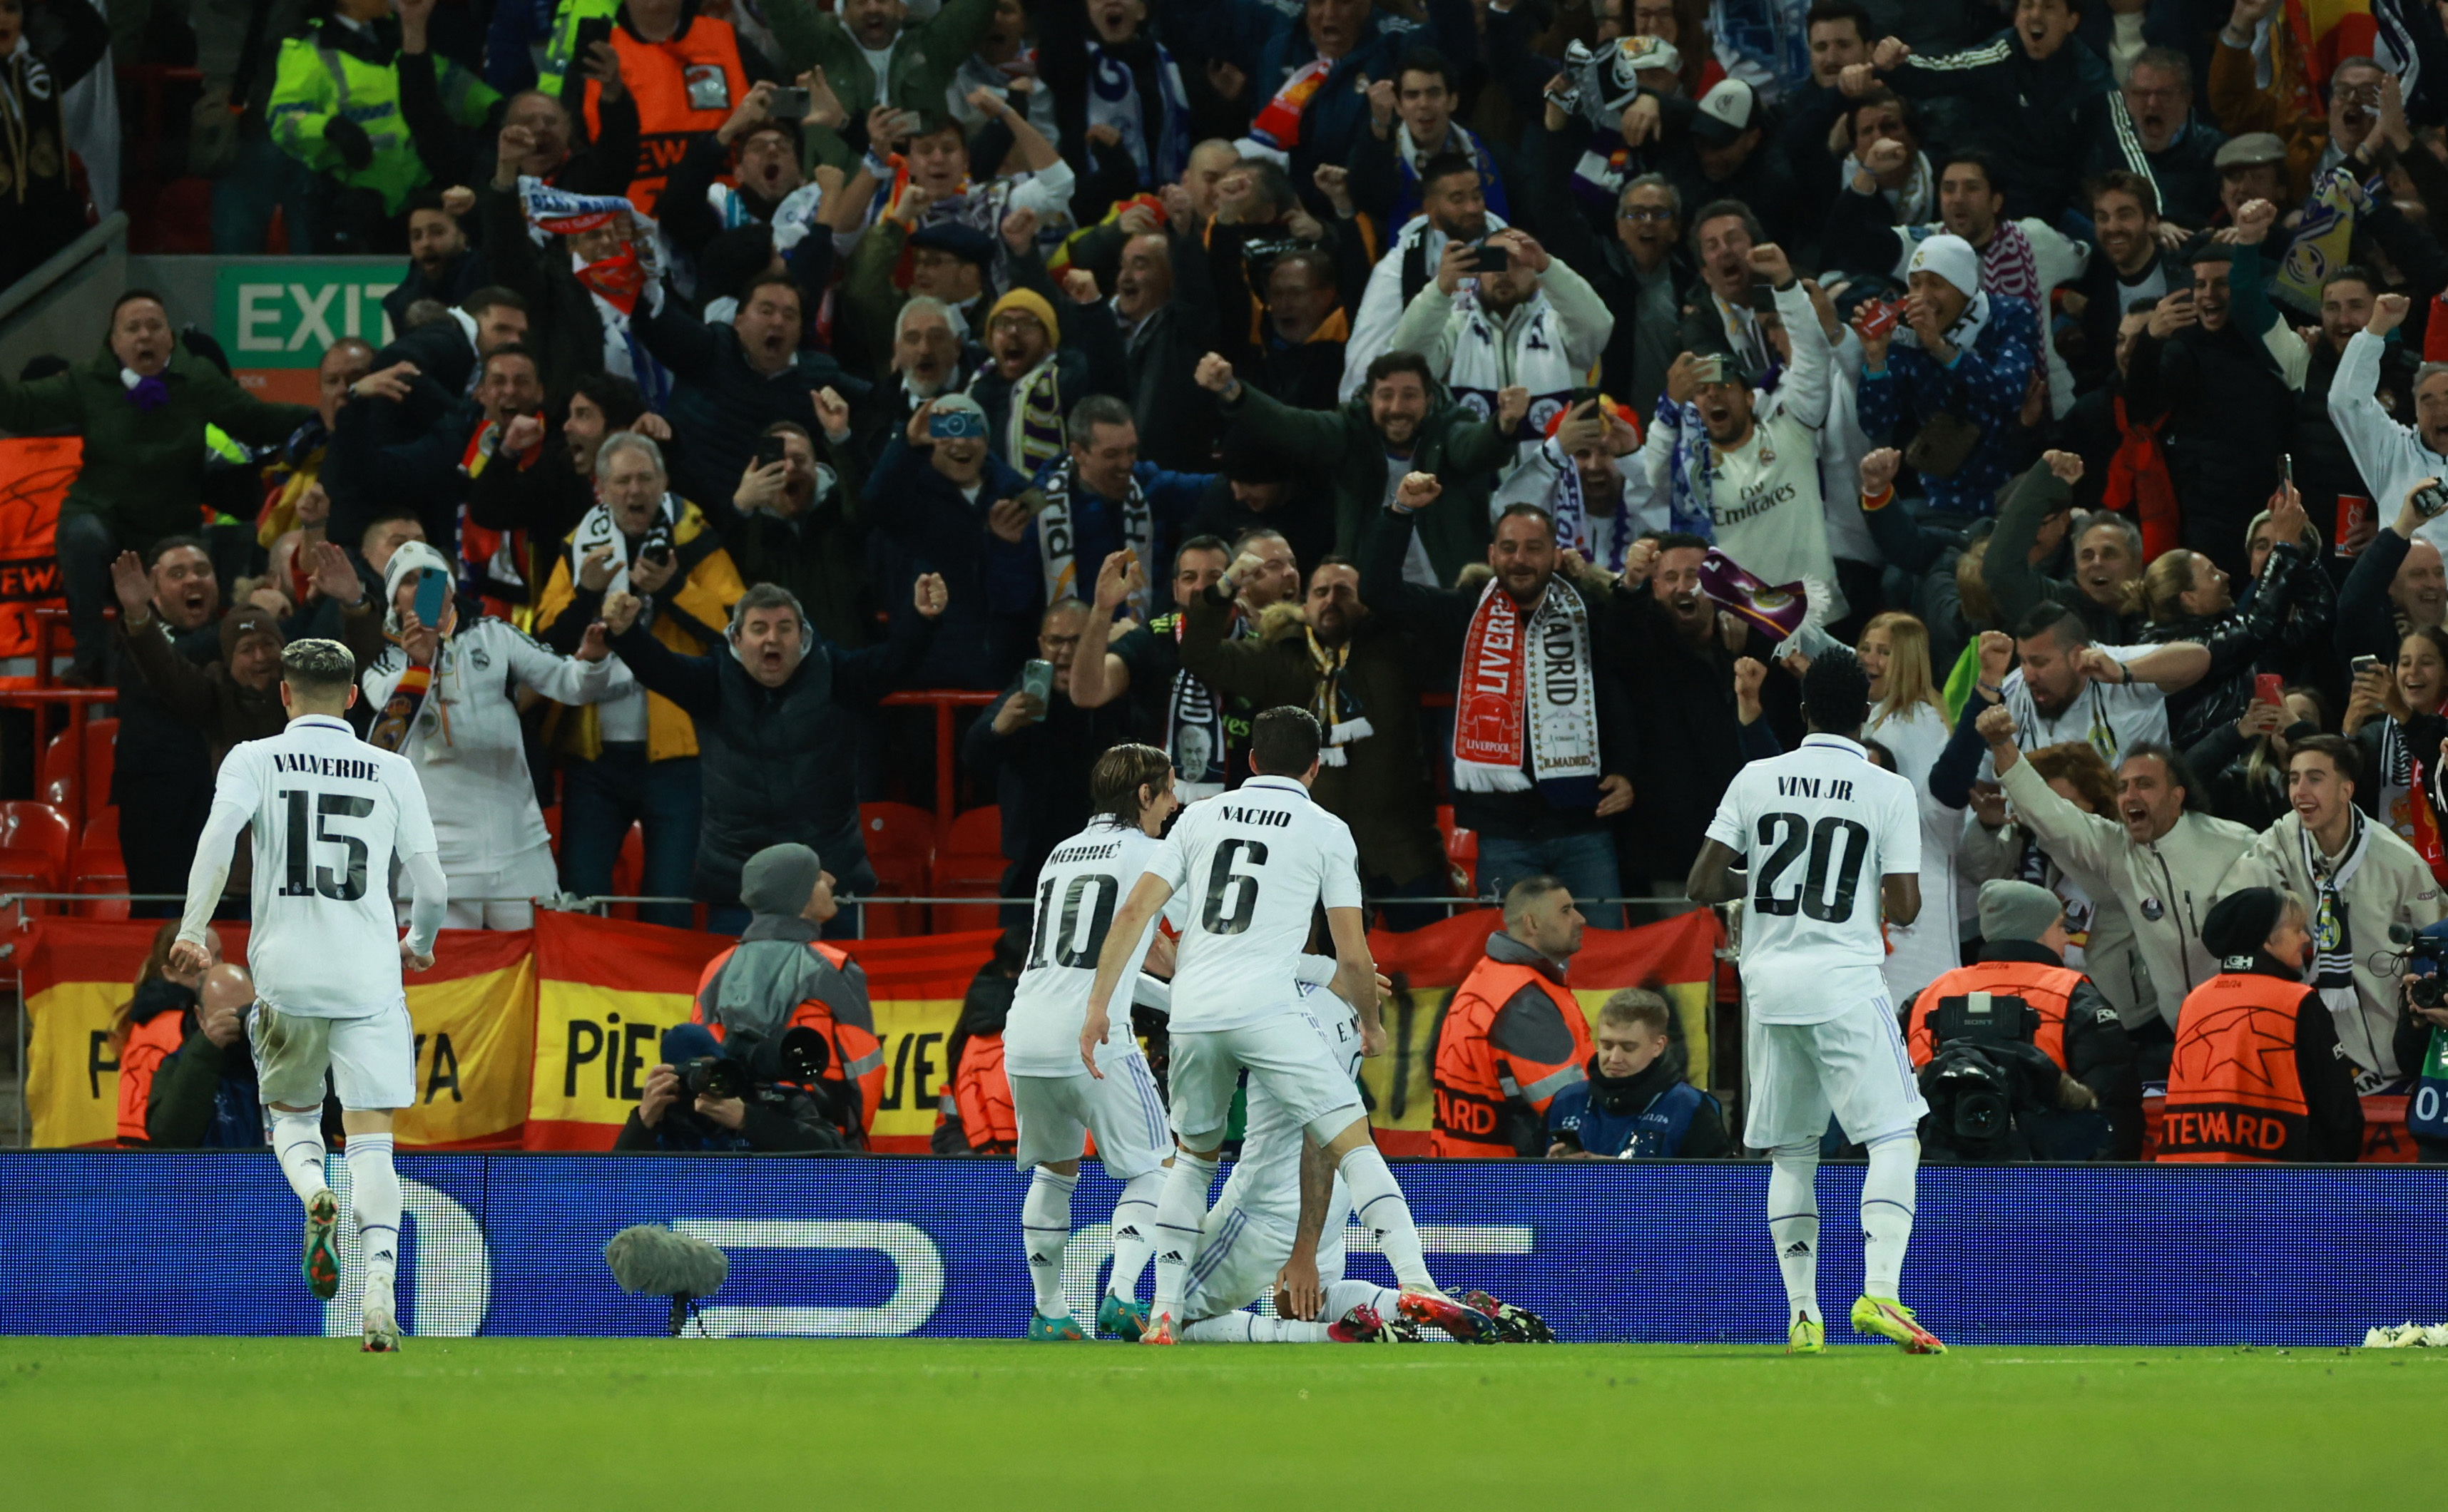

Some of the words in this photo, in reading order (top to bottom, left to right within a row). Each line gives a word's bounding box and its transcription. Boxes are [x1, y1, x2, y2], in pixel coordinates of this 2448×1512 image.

[238, 284, 398, 351] EXIT
[1713, 482, 1796, 527] Emirates
[1467, 739, 1510, 753] LIVERPOOL
[273, 753, 380, 782] VALVERDE
[1778, 776, 1821, 799] VINI
[1824, 779, 1855, 803] JR.
[1218, 805, 1292, 828] NACHO
[278, 790, 376, 901] 15
[1753, 812, 1870, 924] 20
[1201, 838, 1269, 936] 6
[1026, 873, 1119, 972] 10
[2158, 1111, 2287, 1150] TEWARD
[1115, 1234, 1145, 1243] adidas
[1784, 1250, 1814, 1260] adidas
[1158, 1258, 1187, 1267] adidas
